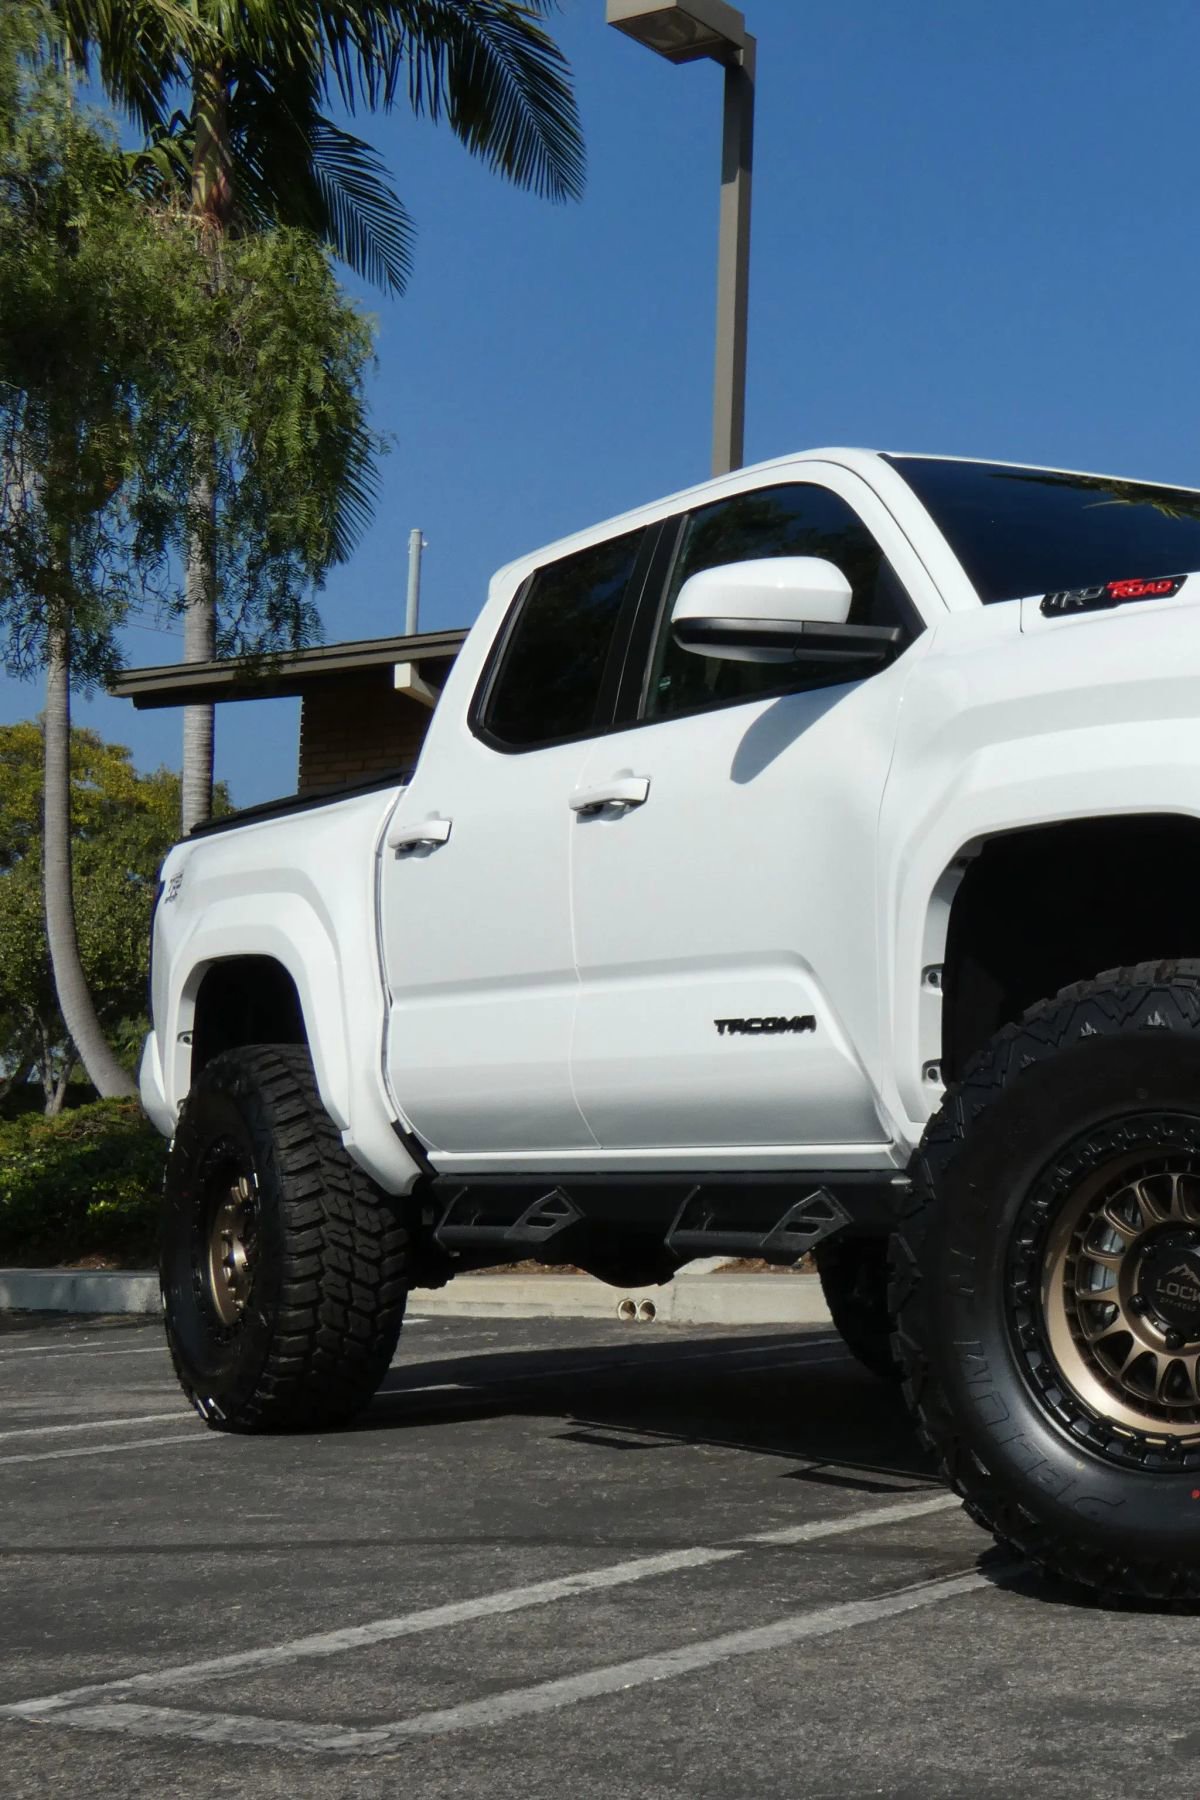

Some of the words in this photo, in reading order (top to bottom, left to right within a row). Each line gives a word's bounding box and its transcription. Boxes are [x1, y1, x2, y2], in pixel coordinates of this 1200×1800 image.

[1048, 586, 1105, 608] TRD
[1111, 580, 1173, 599] ROAD
[714, 1015, 816, 1035] TACOMA
